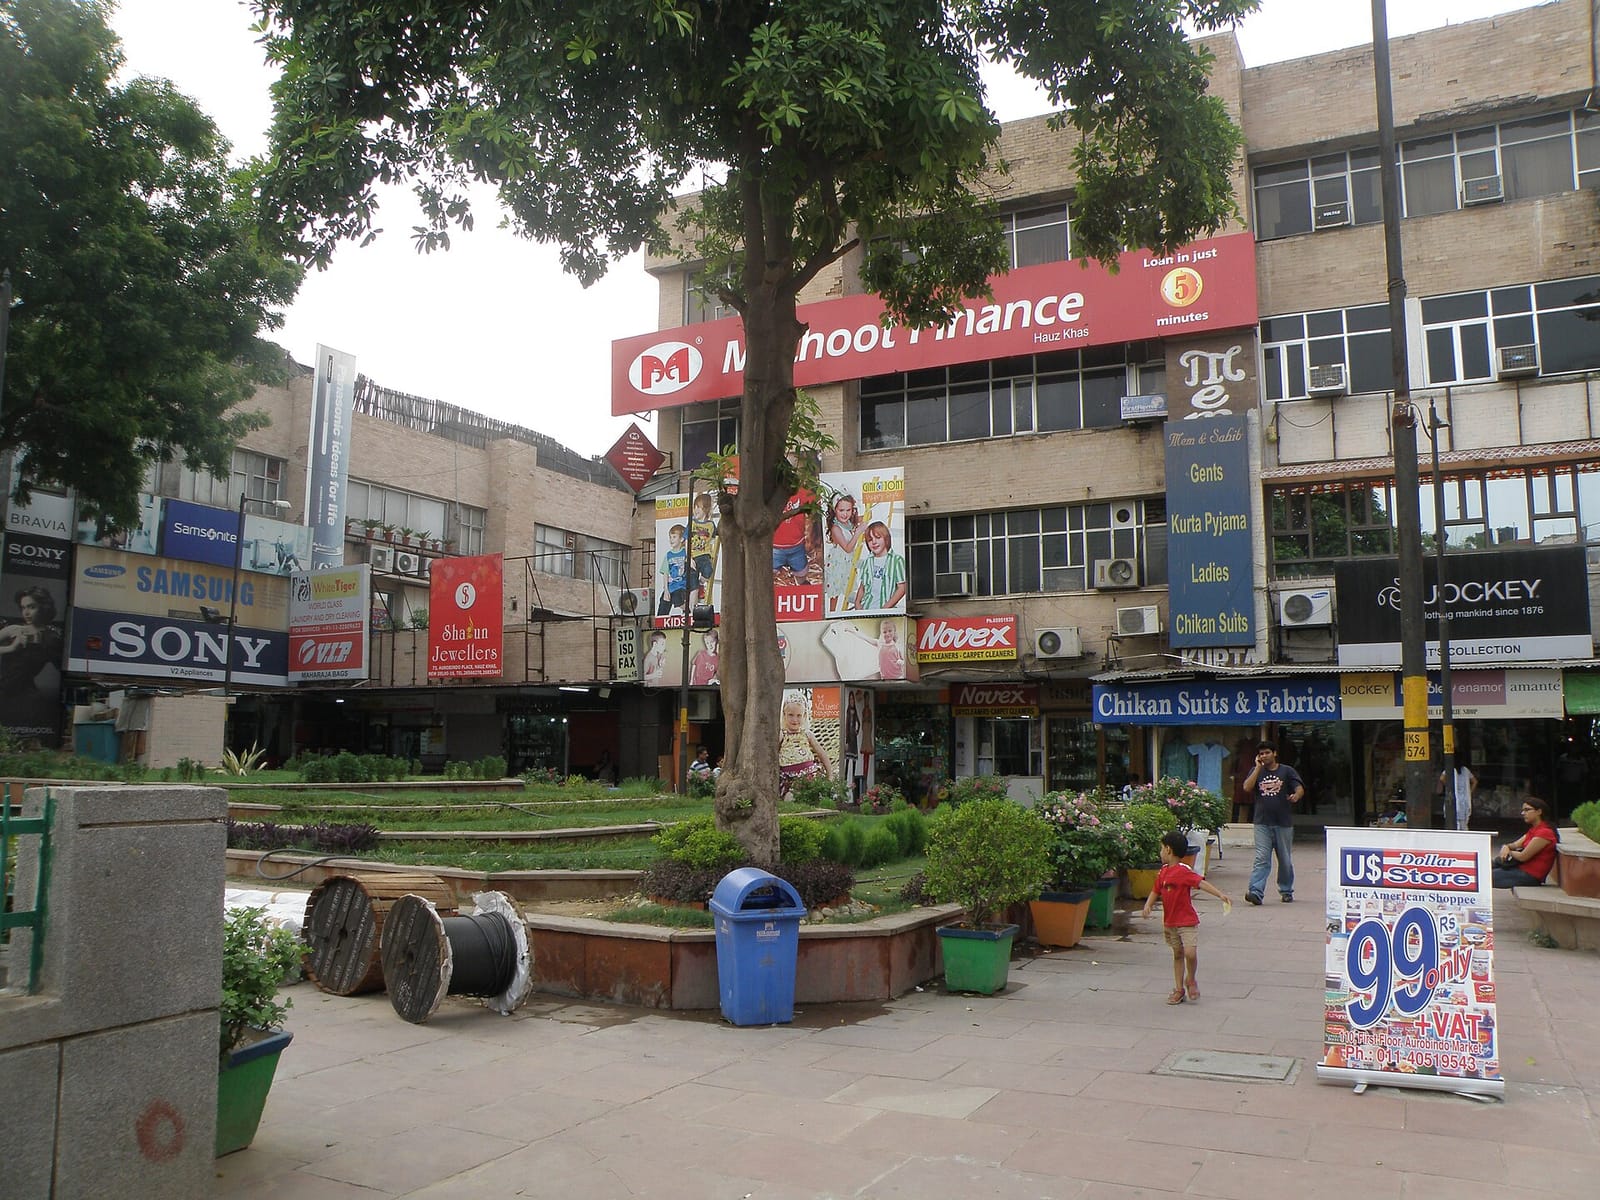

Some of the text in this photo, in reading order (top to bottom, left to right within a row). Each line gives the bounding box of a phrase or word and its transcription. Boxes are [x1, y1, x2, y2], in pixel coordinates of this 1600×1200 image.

[1143, 248, 1218, 268] Loan in just
[1174, 274, 1189, 300] 5
[1156, 311, 1209, 326] minutes
[1034, 327, 1089, 345] Hauz Khas
[722, 322, 896, 375] Mhoot
[1198, 432, 1207, 445] &
[1209, 427, 1242, 443] Sahib
[330, 439, 343, 478] ideas
[1190, 463, 1224, 483] Gents
[328, 480, 340, 502] for
[10, 512, 67, 532] BRAVIA
[327, 503, 339, 526] life
[173, 522, 238, 543] Samsonite
[1171, 512, 1247, 537] Kurta Pyjama
[8, 543, 66, 560] SONY
[1191, 562, 1229, 584] Ladies
[136, 566, 254, 606] SAMSUNG
[1423, 579, 1541, 605] JOCKEY
[777, 594, 819, 613] HUT
[1455, 609, 1493, 618] mankind
[1495, 607, 1519, 616] since
[1521, 606, 1544, 615] 1876
[663, 617, 686, 628] KIDS
[1175, 612, 1249, 635] Chikan Suits
[109, 621, 271, 668] SONY
[617, 629, 634, 642] STD
[919, 622, 1012, 650] Novex
[431, 643, 498, 662] Jewellers
[619, 643, 634, 655] ISD
[919, 650, 1014, 661] DRY CLEANERS CARPET CLEANERS
[1448, 644, 1521, 656] COLLECTION
[618, 656, 636, 669] FAX
[180, 668, 214, 679] Appliances
[301, 669, 348, 678] MAHARAJA BAGS
[1342, 685, 1390, 696] JOCKEY
[1458, 684, 1503, 693] enamor
[1510, 678, 1561, 692] amanté
[959, 686, 1026, 705] Novex
[1097, 691, 1172, 717] Chikan
[1177, 690, 1232, 715] Suits
[1233, 690, 1251, 714] &
[1256, 686, 1337, 713] Fabrics
[1407, 746, 1426, 758] 574
[1345, 853, 1383, 884] U$
[1399, 852, 1456, 867] Dollar
[1388, 867, 1471, 886] Store
[1343, 888, 1368, 899] True
[1428, 893, 1476, 905] Shoppee
[1345, 905, 1440, 1030] 99
[1425, 944, 1474, 990] only
[1358, 1032, 1378, 1044] First
[1379, 1034, 1404, 1047] Floor,
[1405, 1037, 1450, 1051] Aurobindo
[1451, 1040, 1483, 1054] Market
[1377, 1048, 1477, 1072] 011-40519543
